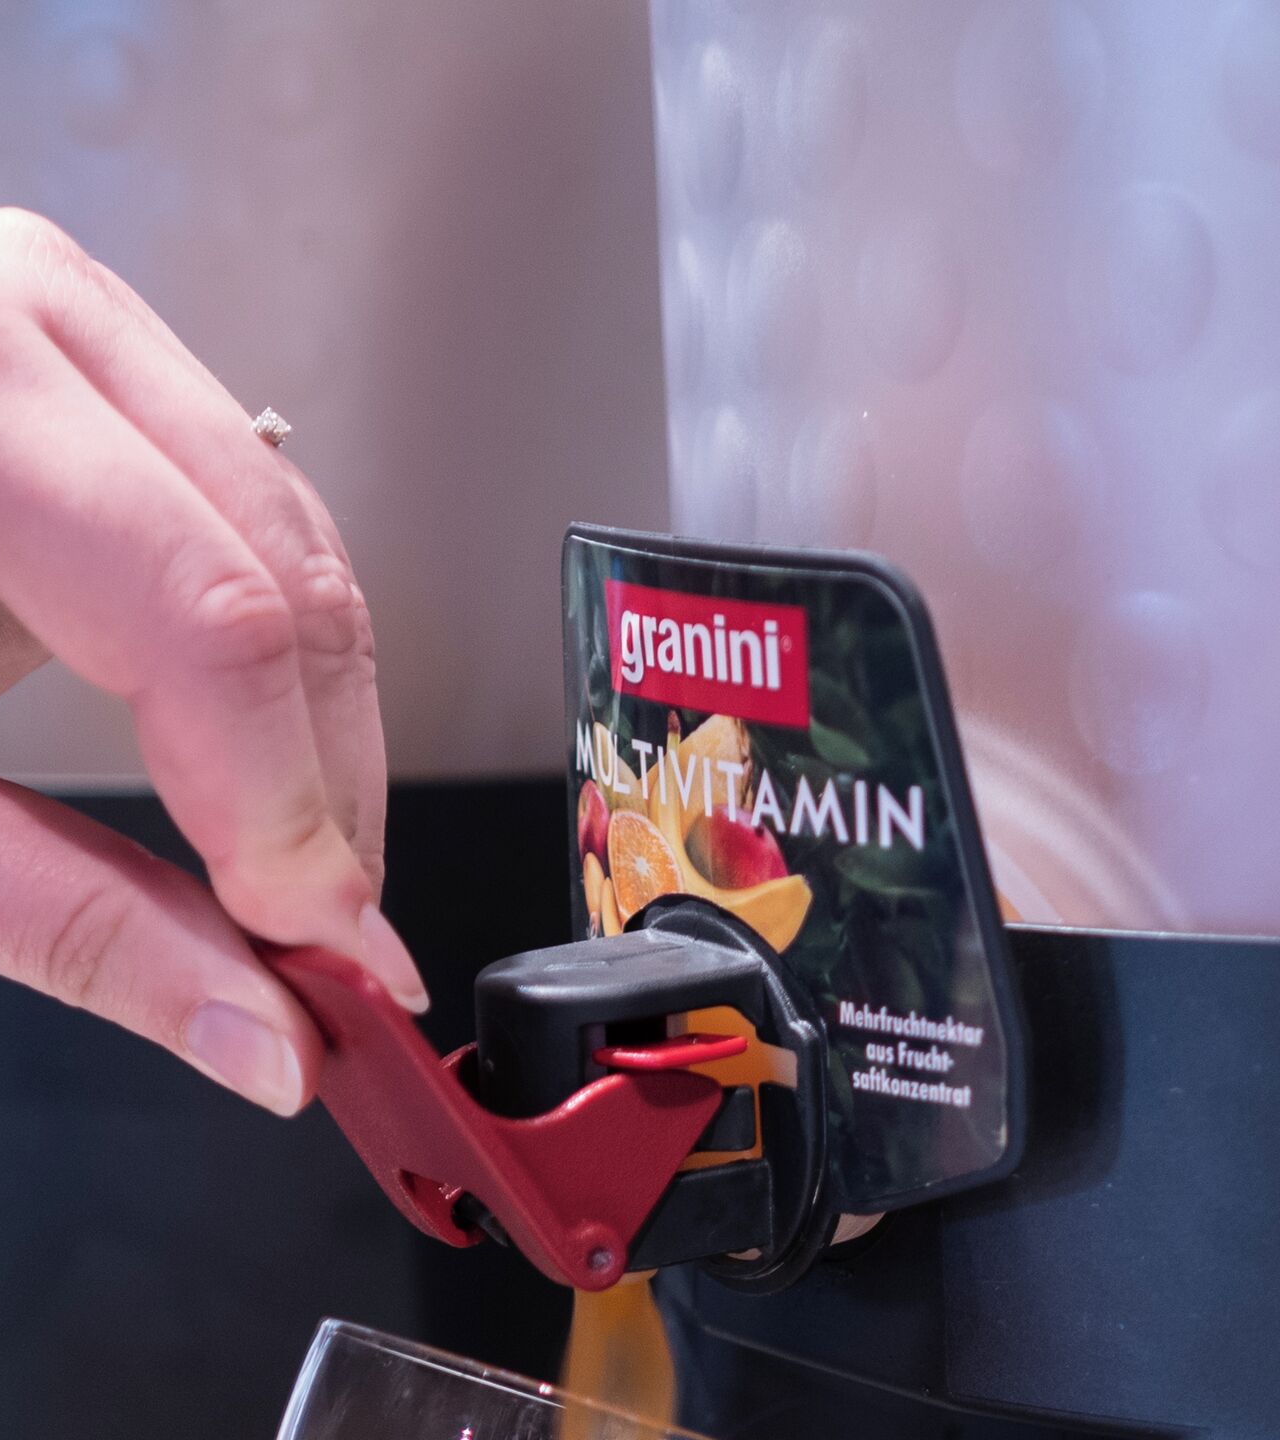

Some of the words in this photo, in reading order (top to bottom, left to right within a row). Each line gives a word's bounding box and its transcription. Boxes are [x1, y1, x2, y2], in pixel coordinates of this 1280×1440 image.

[620, 608, 782, 690] granini
[576, 718, 924, 851] MULTIVITAMIN
[839, 1000, 984, 1047] Mehrfruchtnektar
[865, 1042, 894, 1065] aus
[897, 1041, 955, 1073] Frucht-
[852, 1065, 972, 1108] saftkonzentrat
